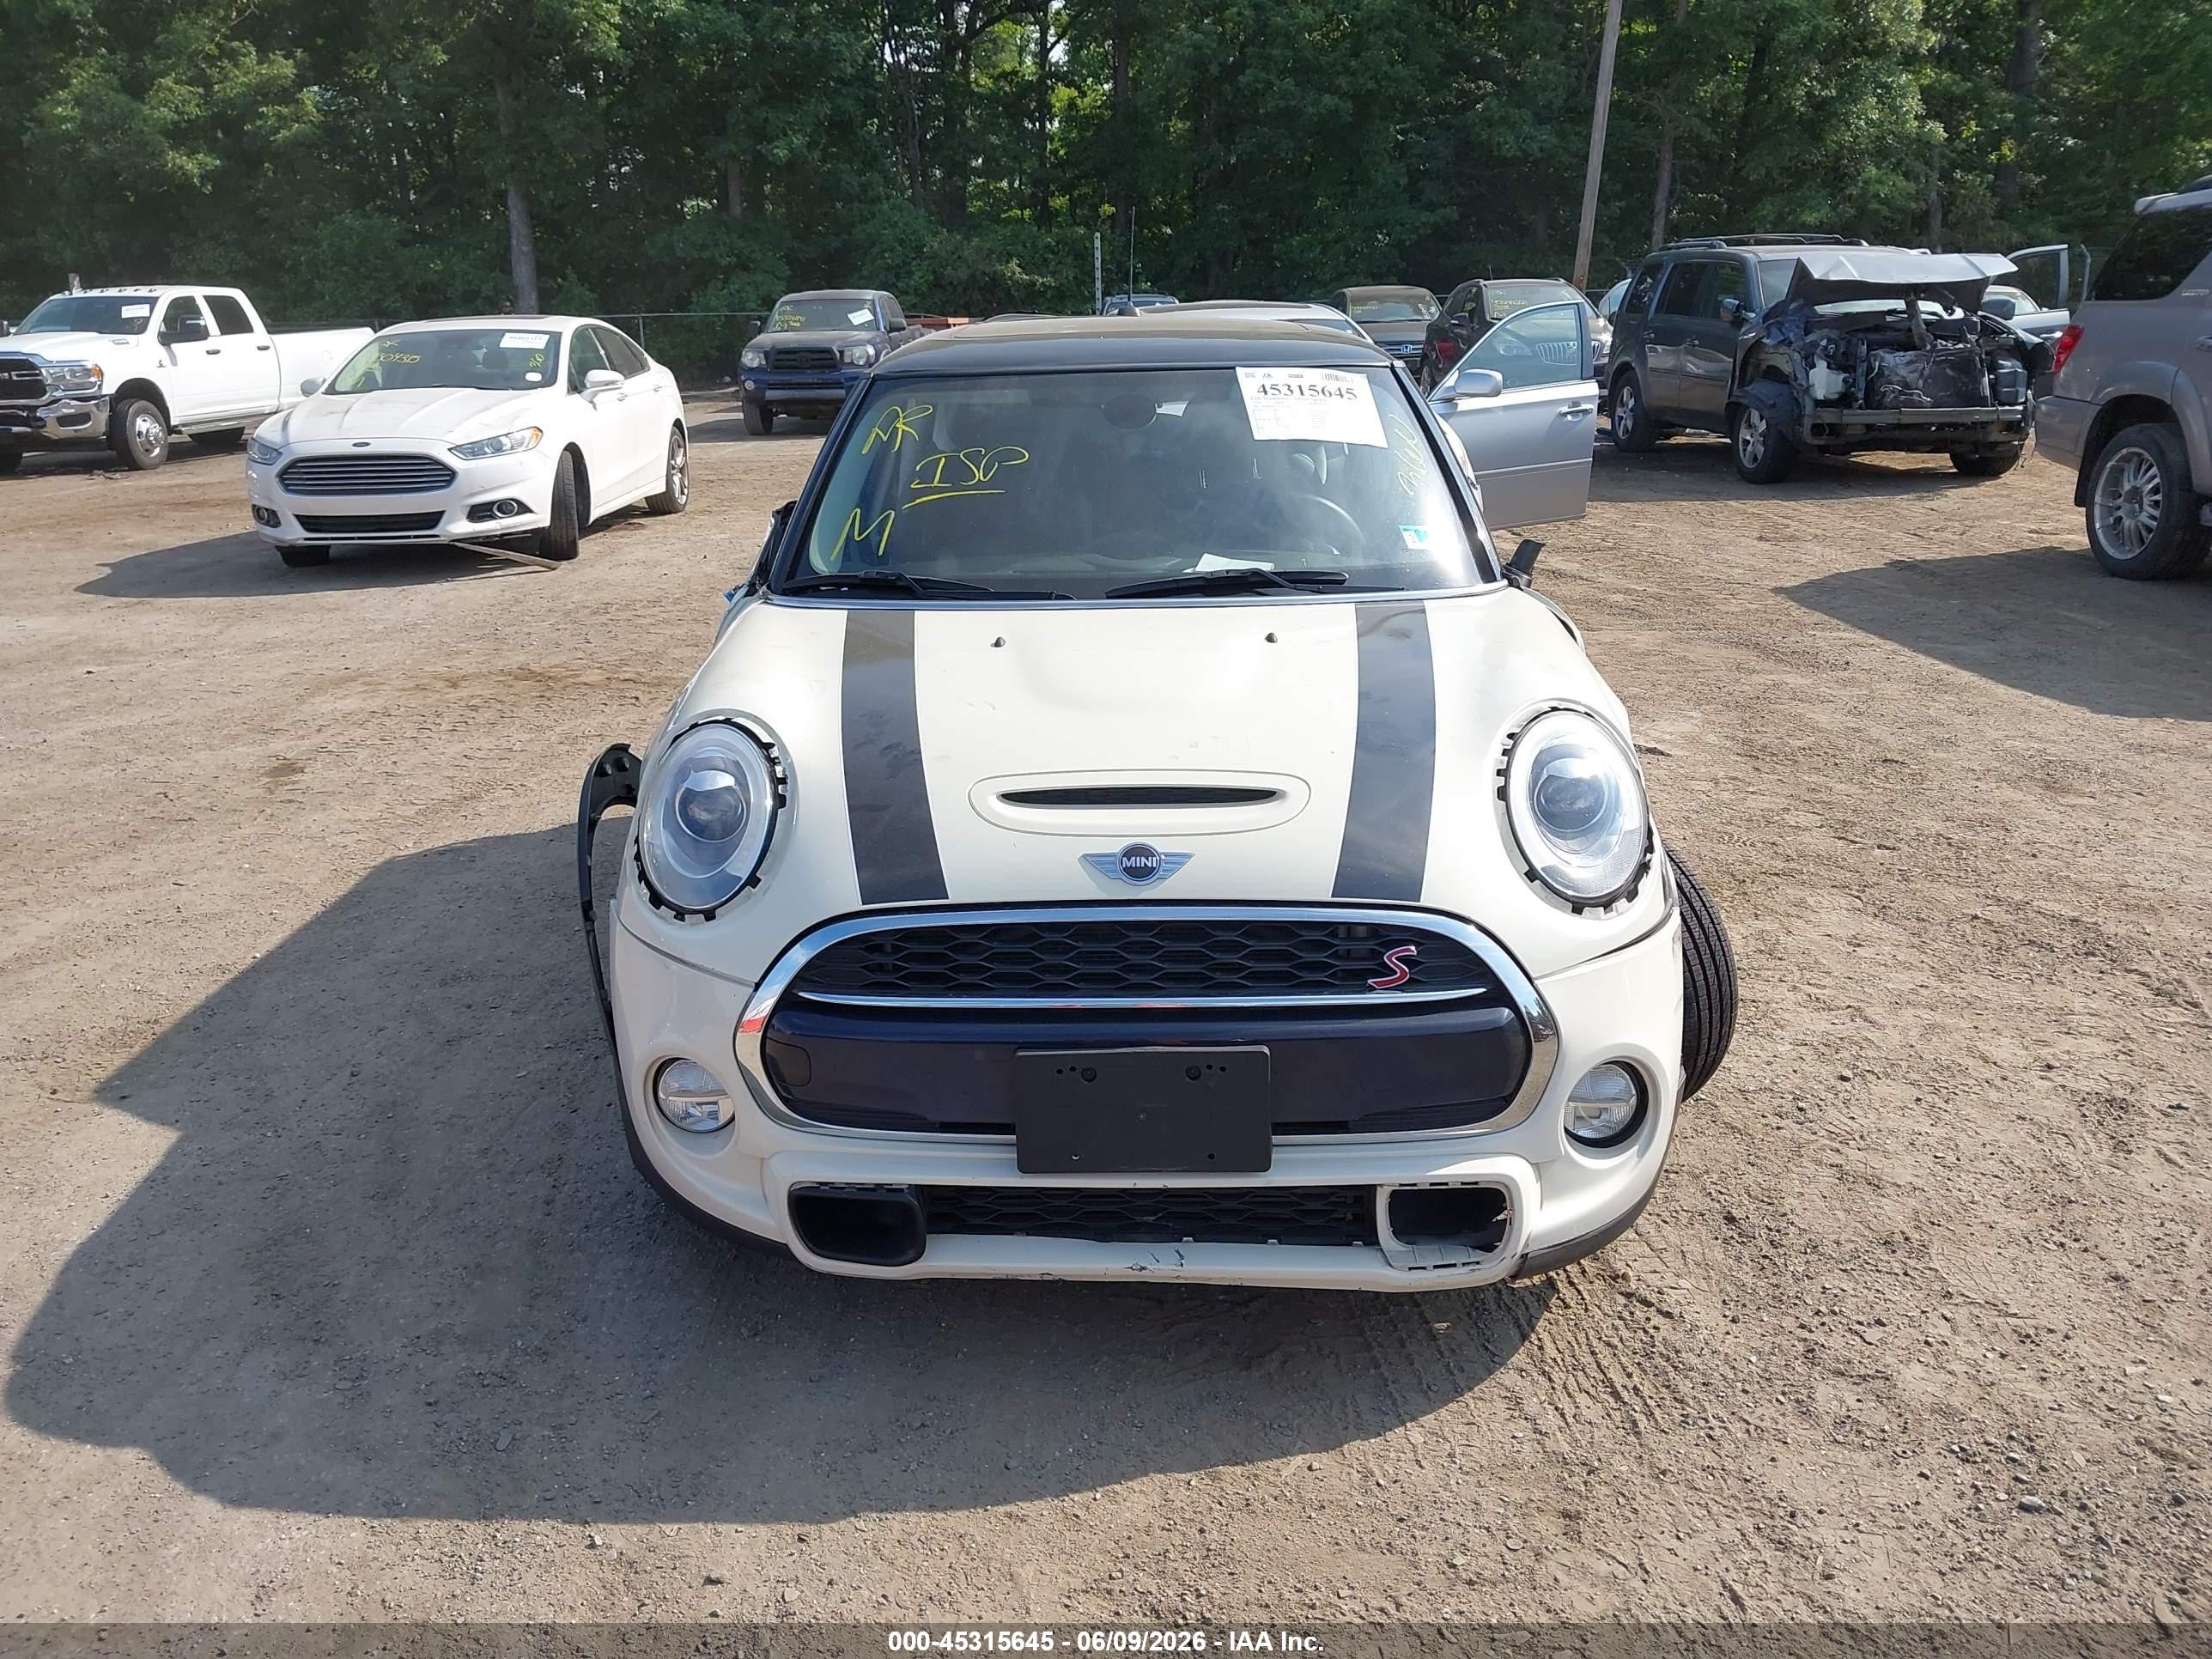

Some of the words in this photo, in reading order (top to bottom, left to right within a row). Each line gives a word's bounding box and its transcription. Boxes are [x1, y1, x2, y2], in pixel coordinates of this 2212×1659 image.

[1256, 383, 1358, 401] 45315645
[830, 507, 896, 562] M
[1121, 856, 1158, 868] MINI
[1367, 945, 1417, 989] S
